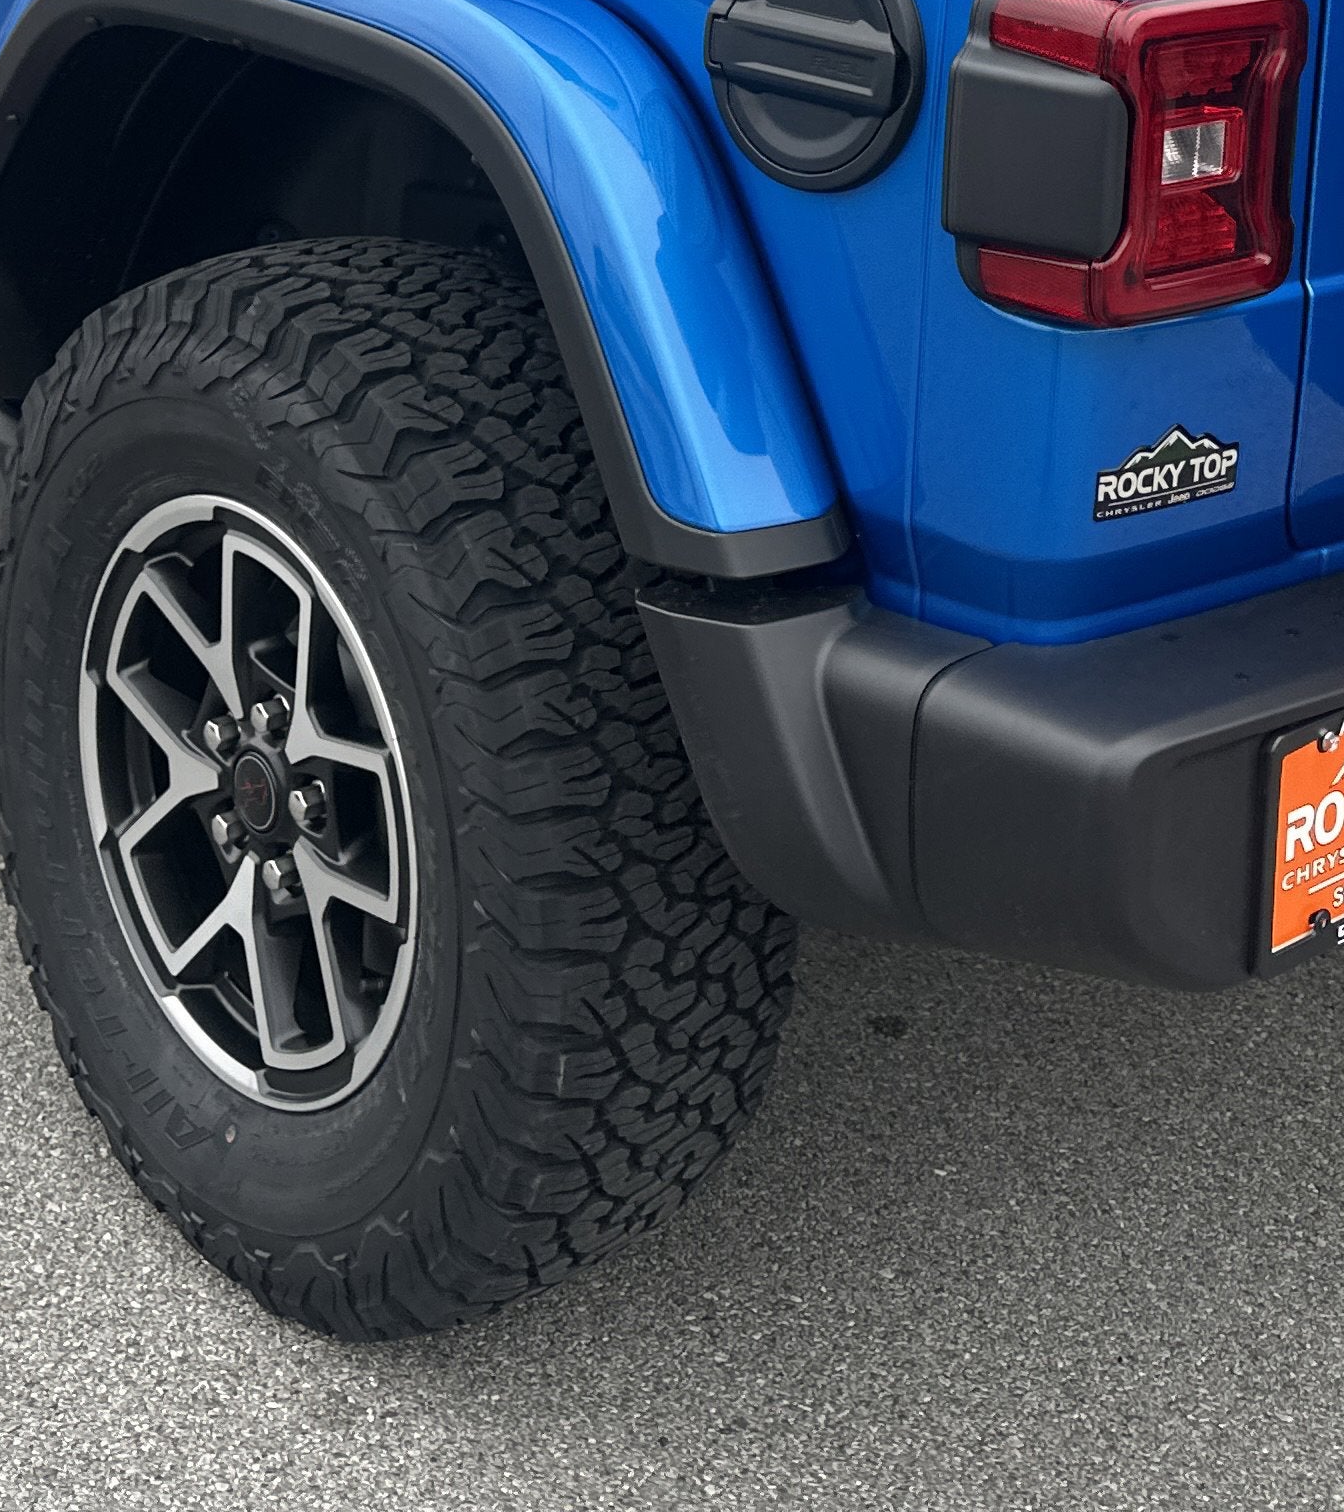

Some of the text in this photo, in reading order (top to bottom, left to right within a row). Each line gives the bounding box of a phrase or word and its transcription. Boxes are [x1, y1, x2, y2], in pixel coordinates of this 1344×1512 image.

[1097, 449, 1238, 502] ROCKY TOP
[1096, 499, 1162, 518] CHRYSLER
